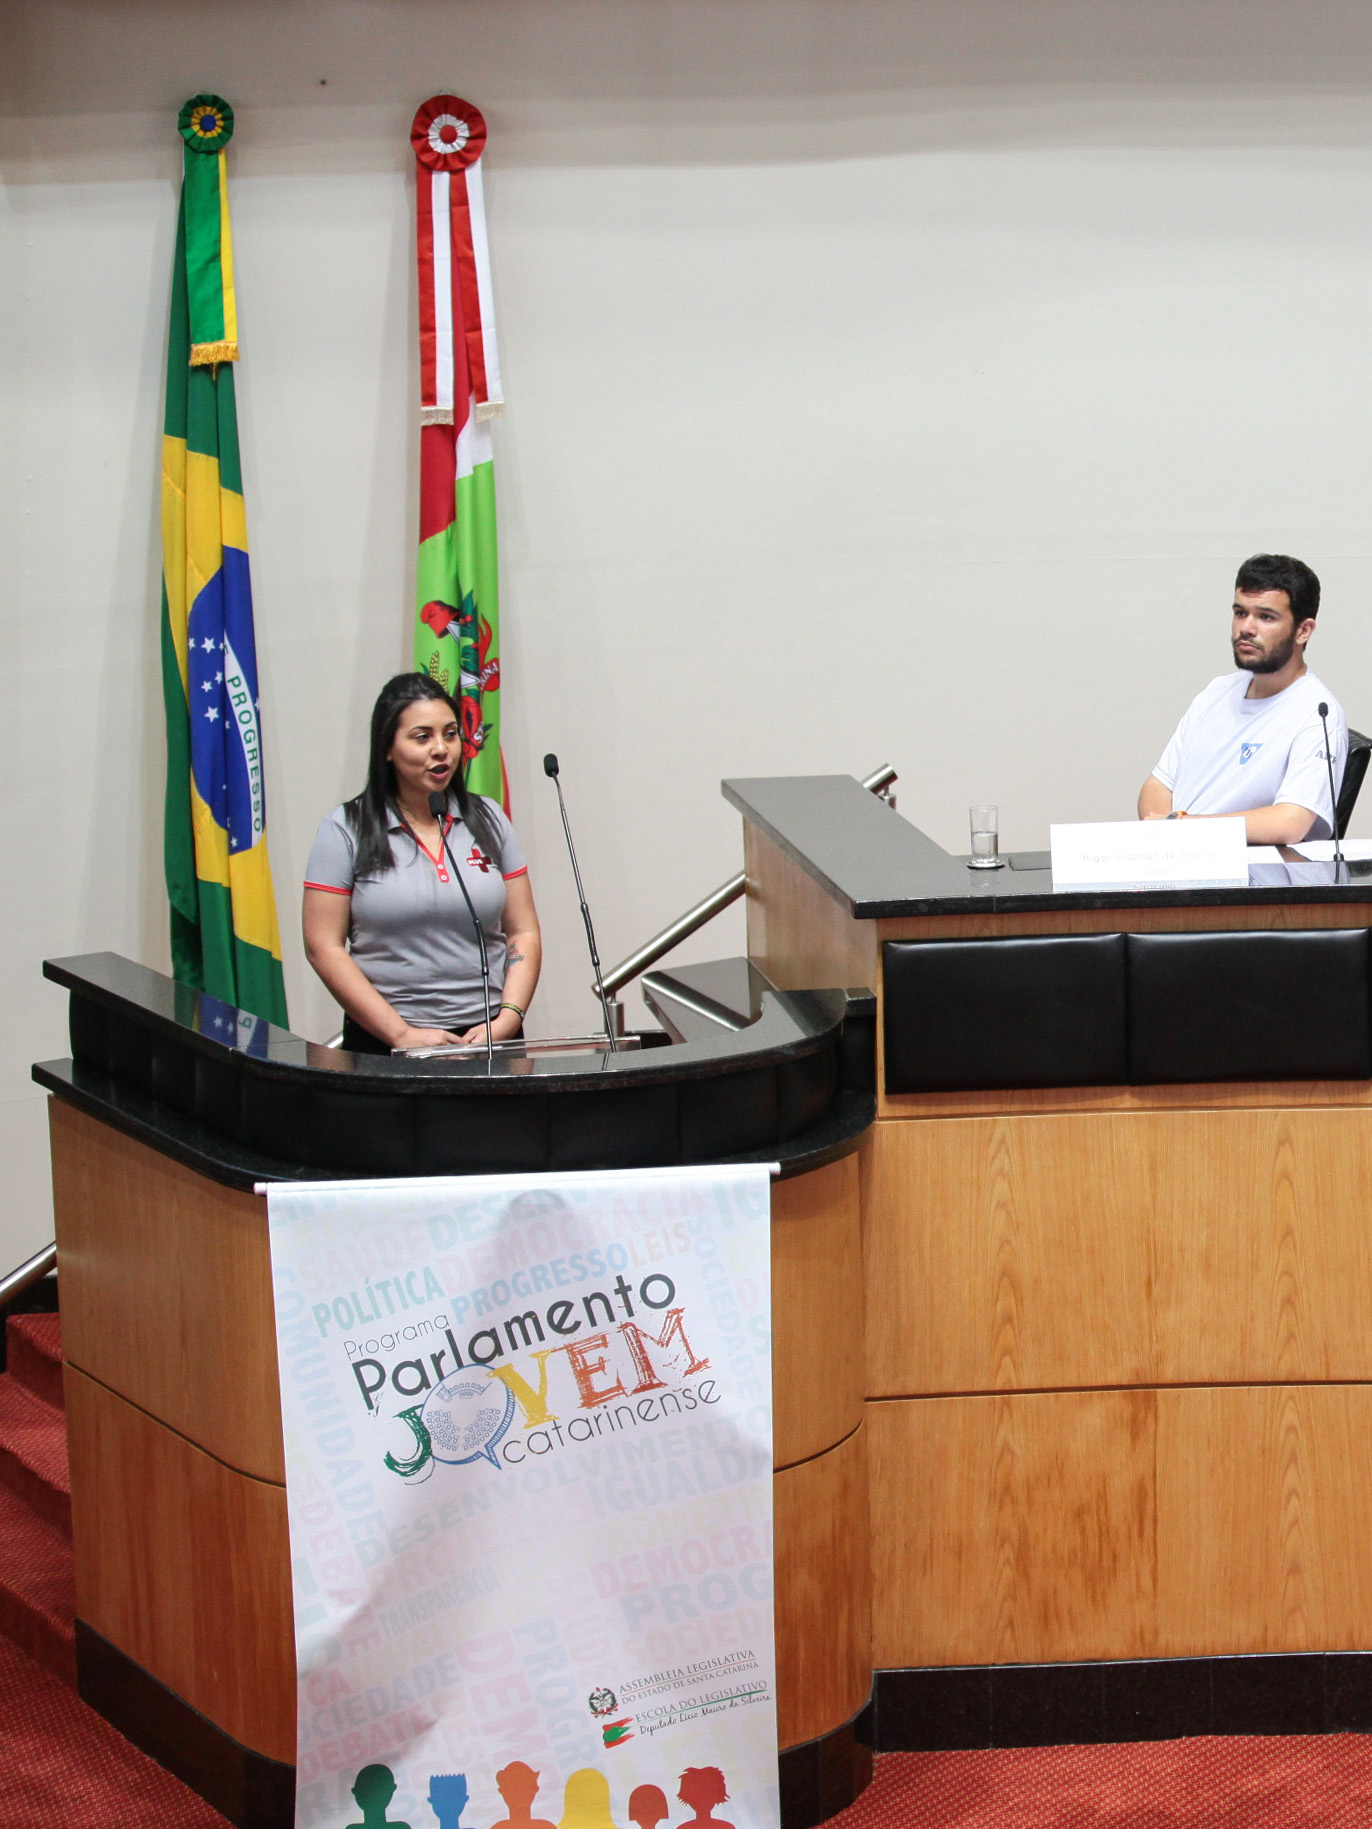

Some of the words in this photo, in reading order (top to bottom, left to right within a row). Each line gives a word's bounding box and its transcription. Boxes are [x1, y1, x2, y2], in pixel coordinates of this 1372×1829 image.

[227, 675, 263, 832] PROGRESSO
[311, 1265, 447, 1340] POLÍTICA
[450, 1242, 630, 1326] PROGRESSO
[626, 1221, 692, 1269] LEIS
[343, 1313, 451, 1362] Programa
[352, 1273, 677, 1413] Parlamento
[274, 1266, 389, 1542] COMUNIDADE
[501, 1378, 723, 1465] catarinense
[619, 1667, 685, 1695] ASSEMBLEIA
[686, 1649, 755, 1675] LEGISLATIVA
[621, 1694, 637, 1705] DO
[638, 1684, 672, 1700] ESTADO
[673, 1680, 685, 1690] DE
[686, 1673, 715, 1687] SANTA
[716, 1661, 759, 1678] CATARINA
[635, 1702, 677, 1723] ESCOLA
[678, 1697, 698, 1711] DO
[699, 1680, 769, 1705] LEGISLATIVO
[639, 1715, 677, 1737] Deputado
[700, 1704, 728, 1719] Mauro
[728, 1699, 739, 1709] da
